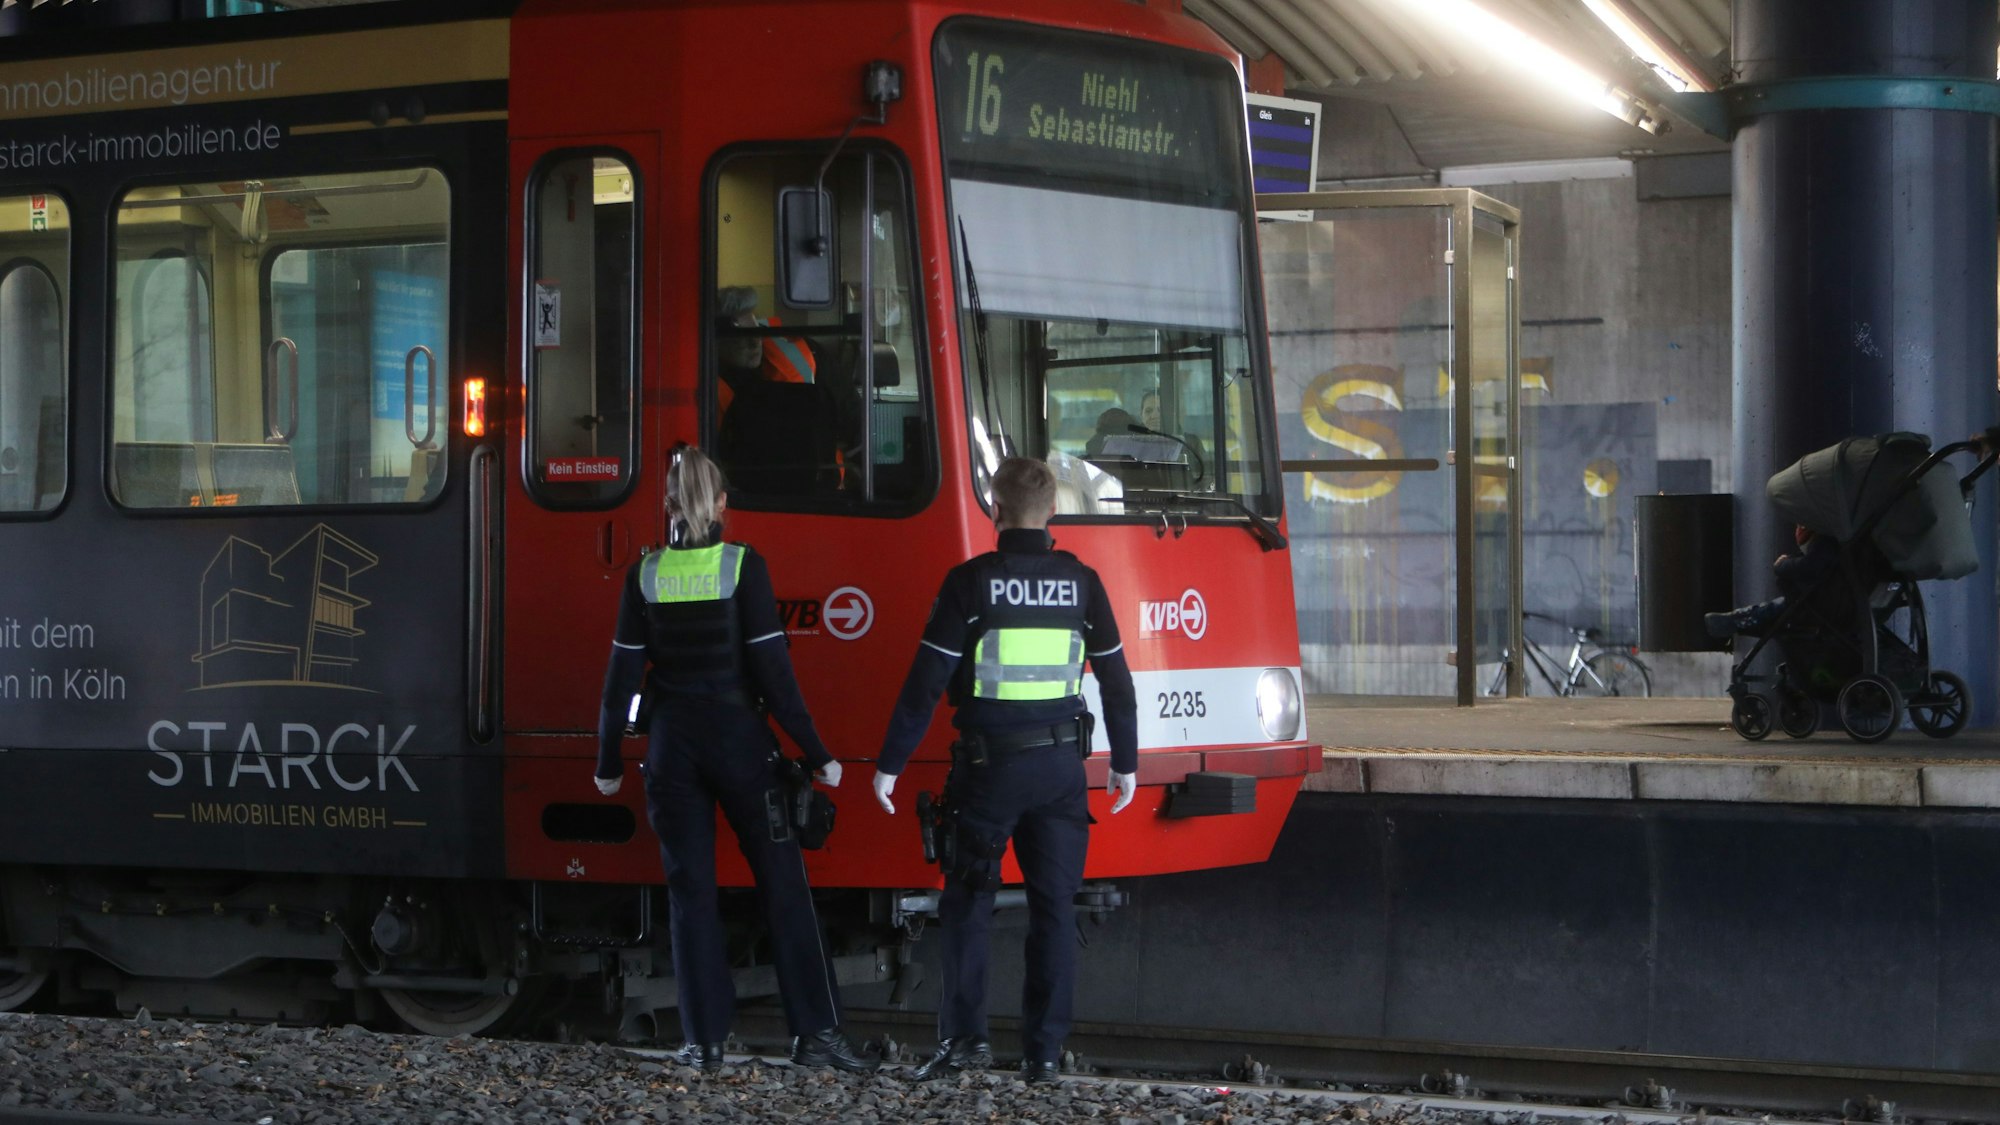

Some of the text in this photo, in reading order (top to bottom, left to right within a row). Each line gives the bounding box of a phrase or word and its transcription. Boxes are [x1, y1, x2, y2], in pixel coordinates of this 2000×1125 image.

[965, 51, 1004, 136] 16
[1082, 72, 1139, 113] Niehl
[1028, 103, 1180, 157] Sebastianstr.
[1259, 110, 1273, 121] Gleis
[549, 461, 619, 477] Kein Einstieg
[656, 574, 720, 597] POLIZEI
[990, 578, 1078, 606] POLIZEI
[1139, 601, 1179, 631] KVB
[0, 617, 94, 648] it dem
[0, 667, 125, 700] n in Köln
[1158, 691, 1206, 718] 2235
[147, 720, 420, 792] STARCK
[191, 802, 387, 829] IMMOBILIEN GMBH
